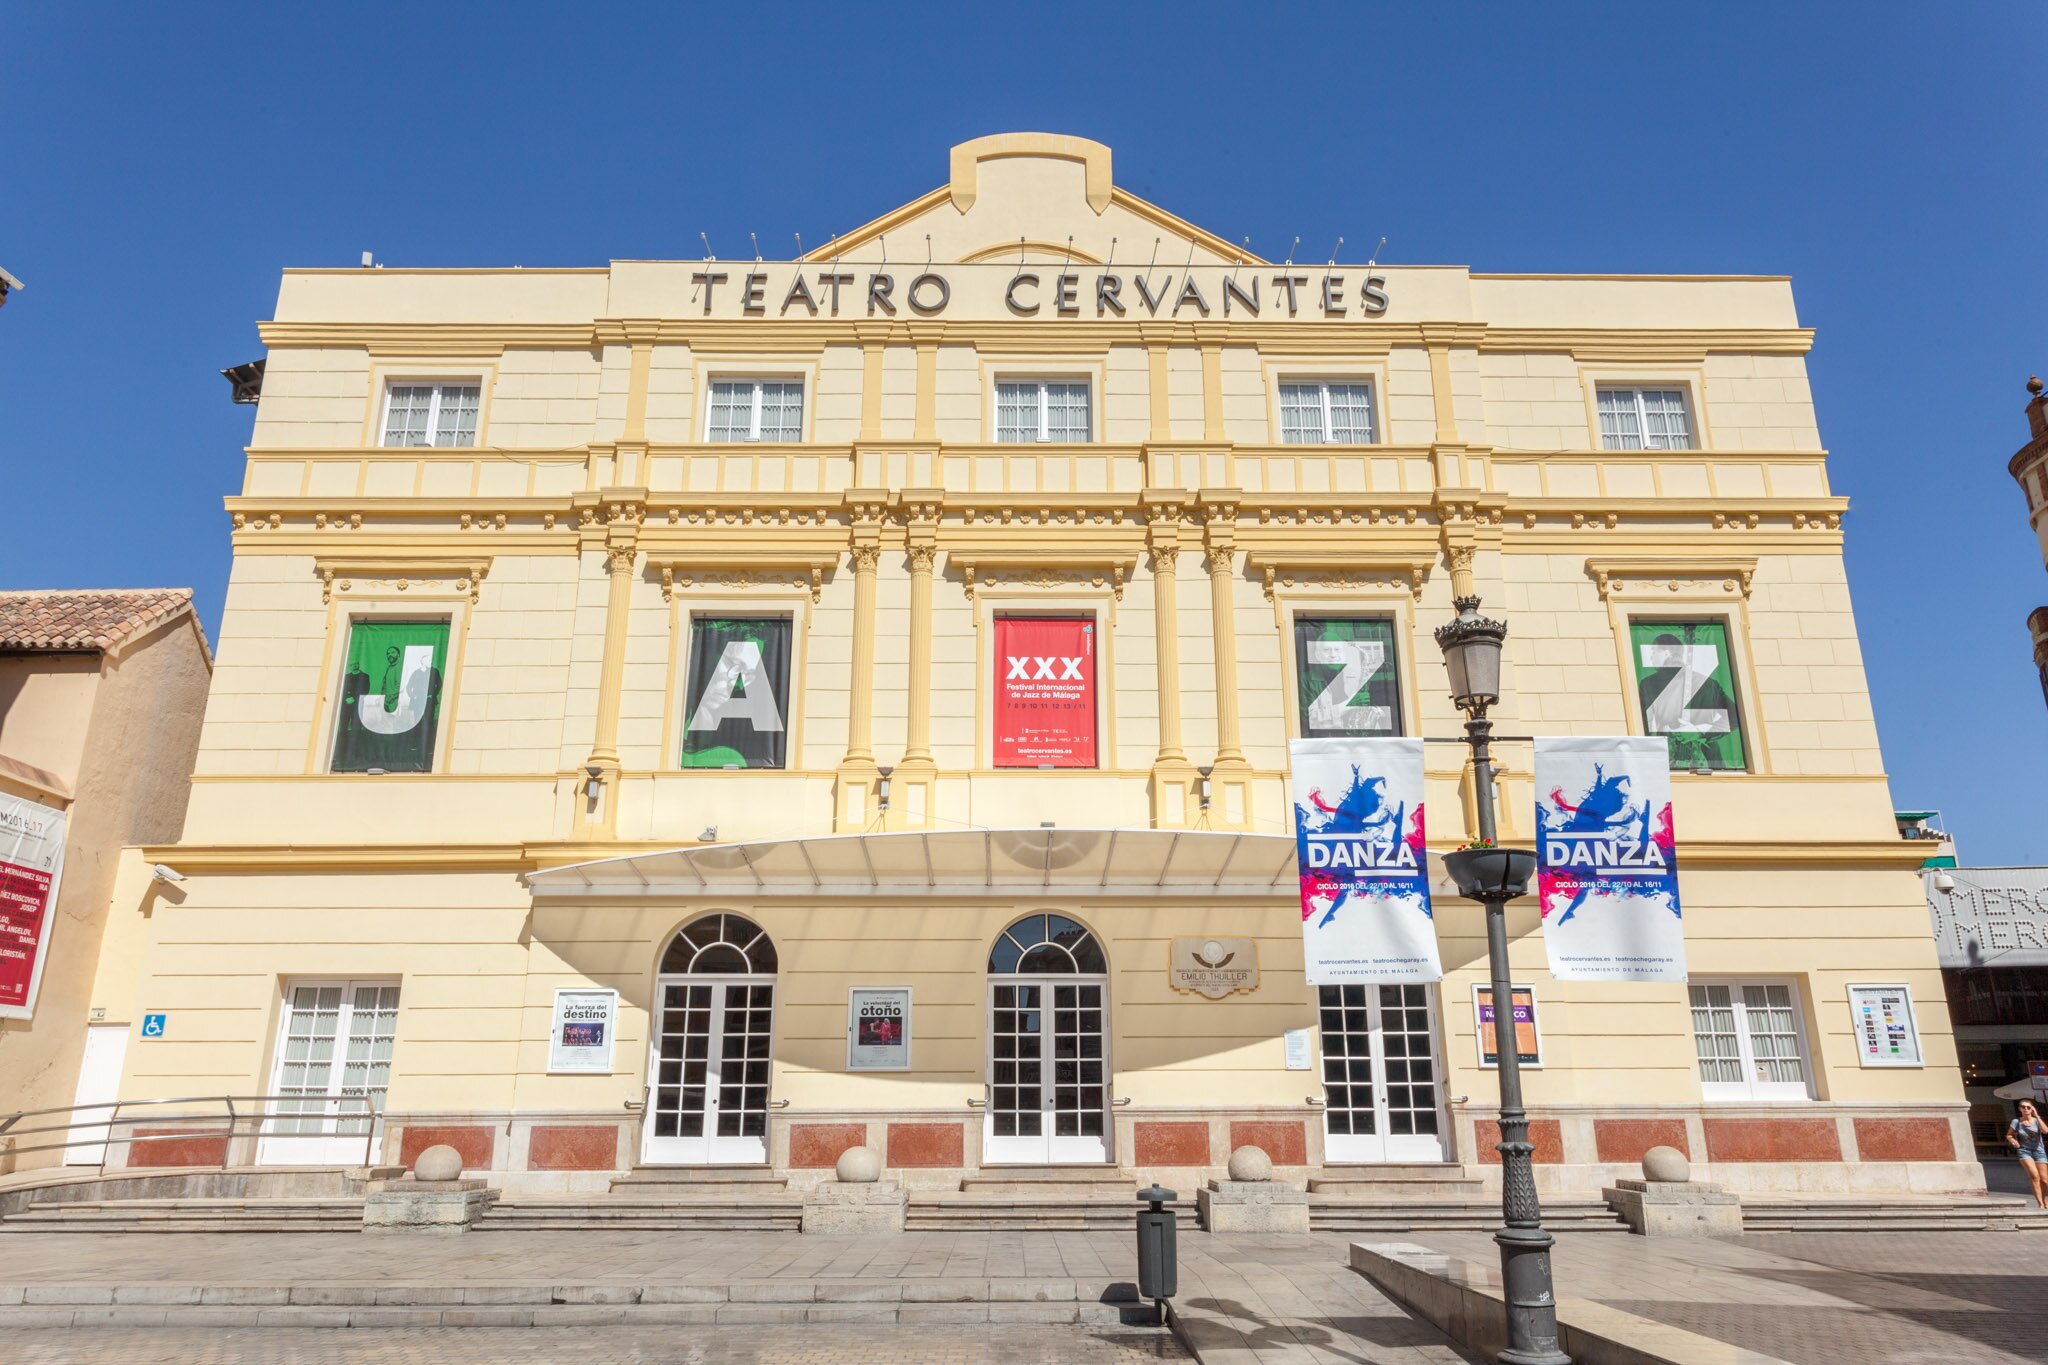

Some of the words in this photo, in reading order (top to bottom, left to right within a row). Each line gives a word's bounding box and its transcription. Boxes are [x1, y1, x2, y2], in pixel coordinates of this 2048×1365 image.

[692, 272, 950, 312] TEATRO
[1006, 273, 1390, 313] CERVANTES
[1006, 656, 1084, 680] XXX
[358, 645, 434, 735] J
[688, 641, 785, 732] A
[1006, 683, 1035, 691] Festival
[1036, 683, 1085, 691] Internacional
[1022, 691, 1040, 699] Jazz
[1052, 691, 1081, 700] Málaga
[1306, 641, 1393, 730] Z
[1640, 645, 1731, 733] Z
[1307, 842, 1418, 868] DANZA
[1546, 840, 1666, 866] DANZA
[563, 1009, 607, 1019] destino
[860, 1005, 901, 1016] otoño
